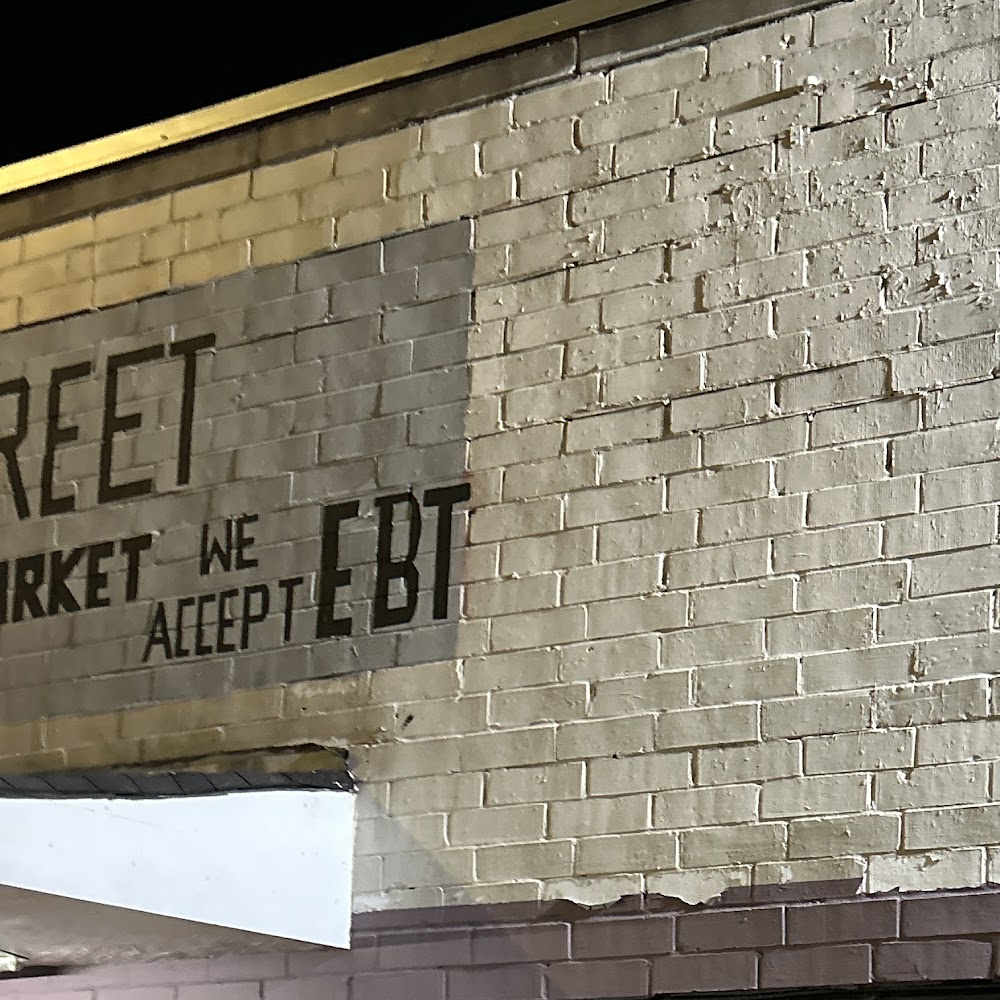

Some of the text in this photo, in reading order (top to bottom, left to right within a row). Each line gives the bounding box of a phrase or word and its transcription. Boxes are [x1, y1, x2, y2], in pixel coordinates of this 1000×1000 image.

[200, 513, 259, 576] WE
[316, 482, 471, 639] EBT
[141, 577, 304, 663] ACCEPT
